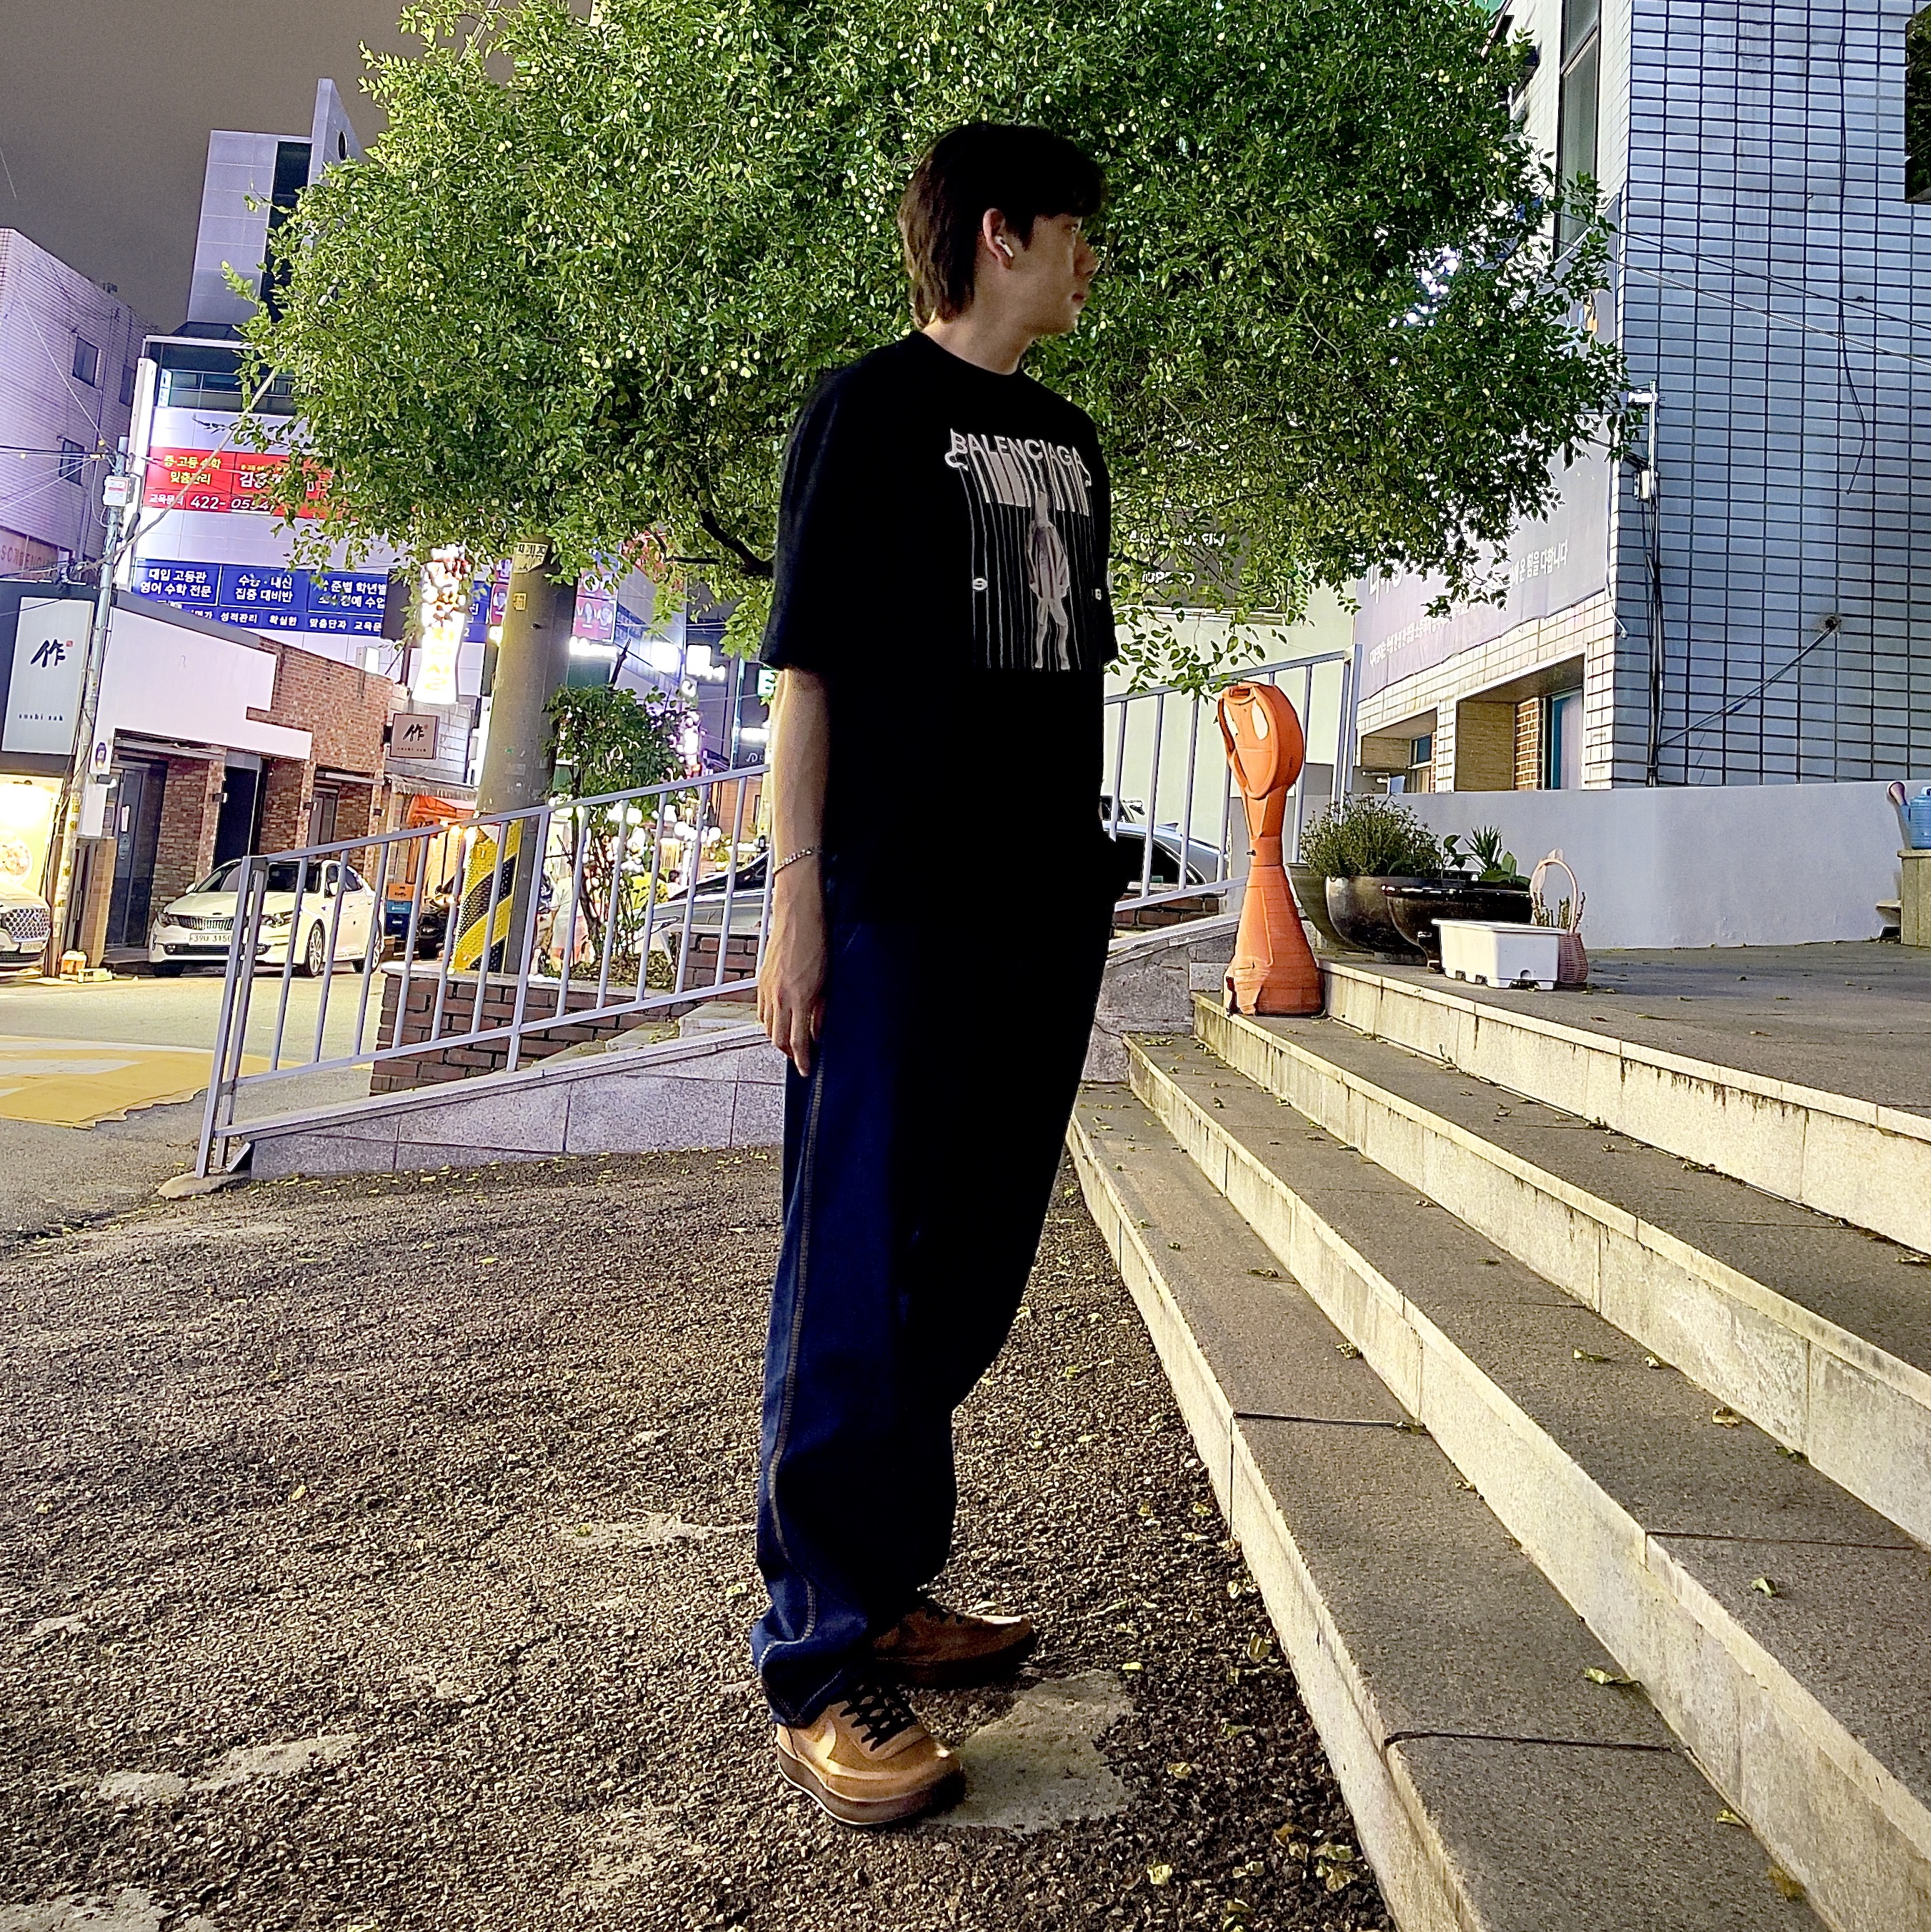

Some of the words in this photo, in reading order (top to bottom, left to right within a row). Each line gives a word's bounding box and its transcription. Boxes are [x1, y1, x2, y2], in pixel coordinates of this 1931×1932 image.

[944, 428, 1092, 489] BALENCIAGA
[1540, 539, 1569, 575] 다합니다
[149, 568, 171, 581] 대입
[140, 581, 162, 594] 영어
[164, 584, 188, 596] 수학
[189, 585, 212, 598] 전문
[235, 587, 257, 601] 집중
[260, 589, 294, 603] 대비반
